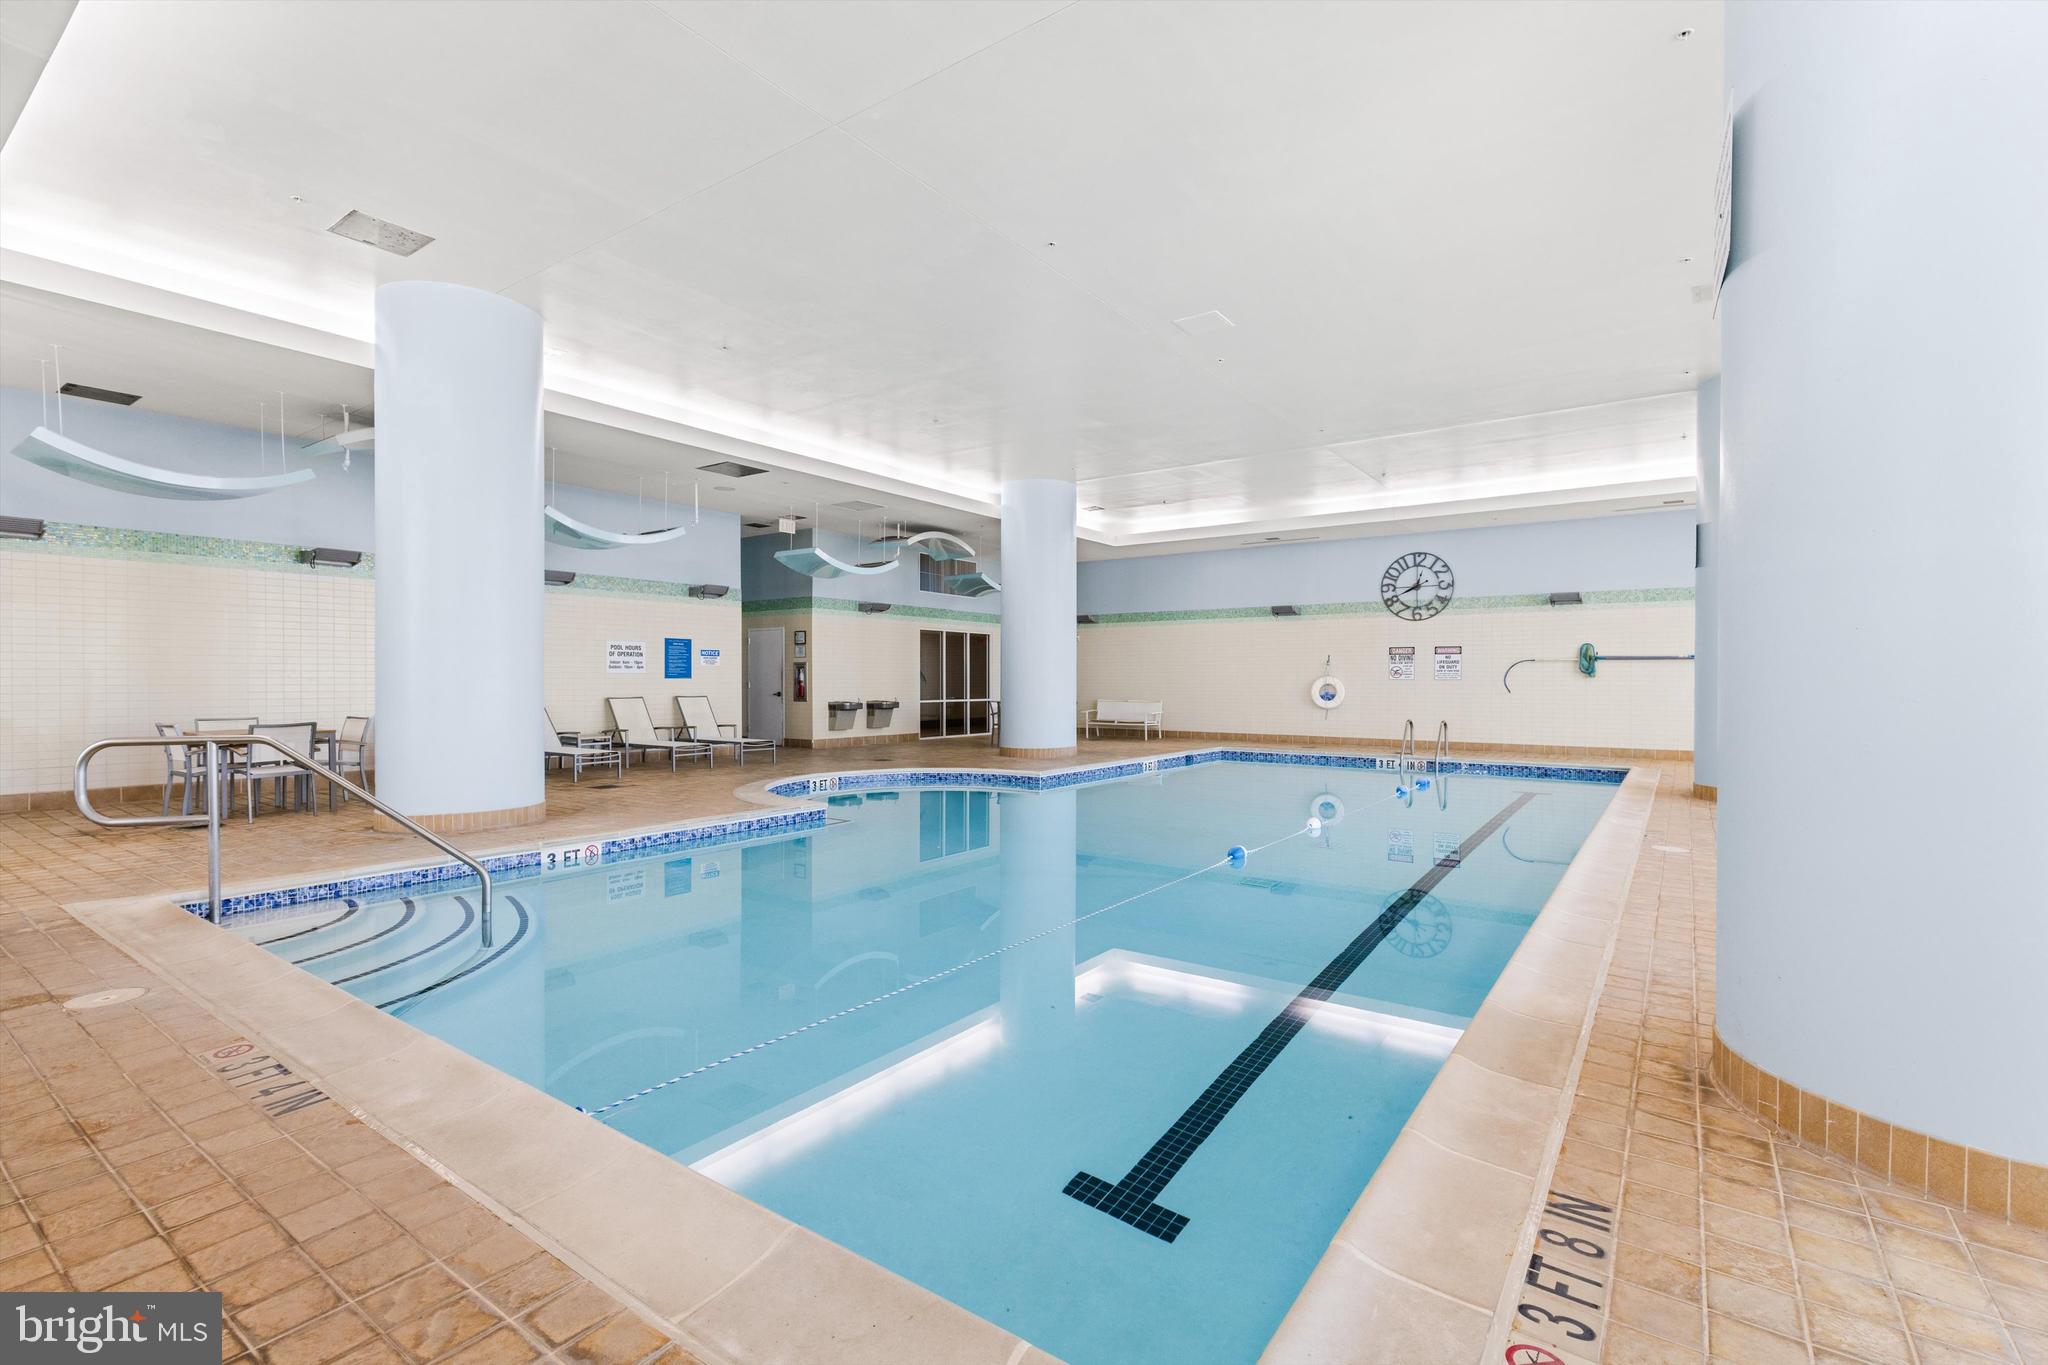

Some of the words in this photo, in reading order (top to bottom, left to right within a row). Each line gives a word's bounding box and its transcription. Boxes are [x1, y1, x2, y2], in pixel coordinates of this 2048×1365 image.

[1412, 552, 1427, 567] 12
[1384, 567, 1401, 581] 10
[1434, 564, 1450, 579] 2
[1381, 583, 1396, 593] 9
[1438, 580, 1453, 590] 3
[1384, 595, 1399, 608] 8
[1412, 606, 1422, 621] 6
[217, 1055, 271, 1073] 3
[226, 1063, 293, 1089] FT
[250, 1080, 307, 1100] 4
[262, 1088, 331, 1117] IN
[1543, 1189, 1613, 1233] IN
[1538, 1228, 1606, 1259] 8
[1525, 1253, 1604, 1310] FT
[1518, 1303, 1597, 1342] 3
